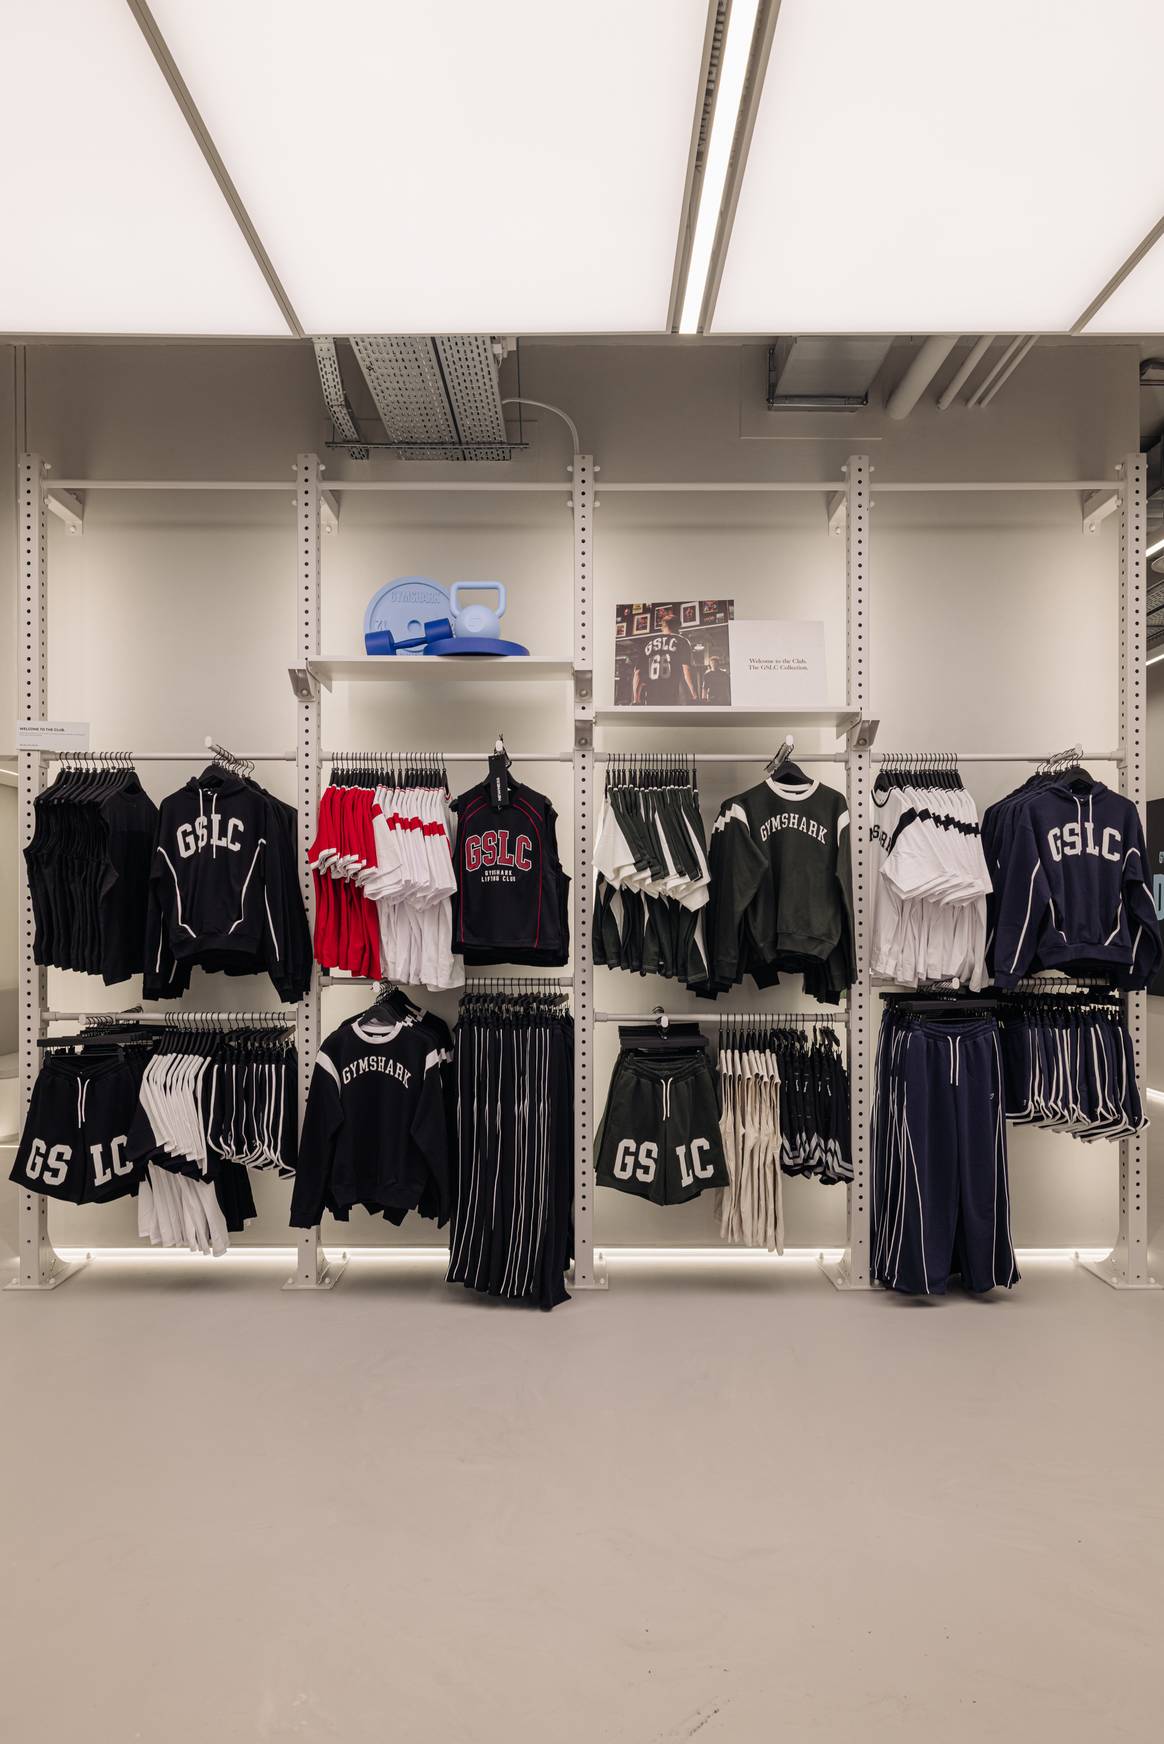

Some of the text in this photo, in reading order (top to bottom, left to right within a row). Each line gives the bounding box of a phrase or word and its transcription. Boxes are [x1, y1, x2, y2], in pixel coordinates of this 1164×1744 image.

[645, 637, 678, 655] GSLC
[177, 813, 245, 859] GSLC
[760, 812, 828, 845] GYMSHARK
[1048, 822, 1122, 862] GSLC
[465, 830, 532, 872] GSLC
[341, 1055, 412, 1089] GYMSHARK
